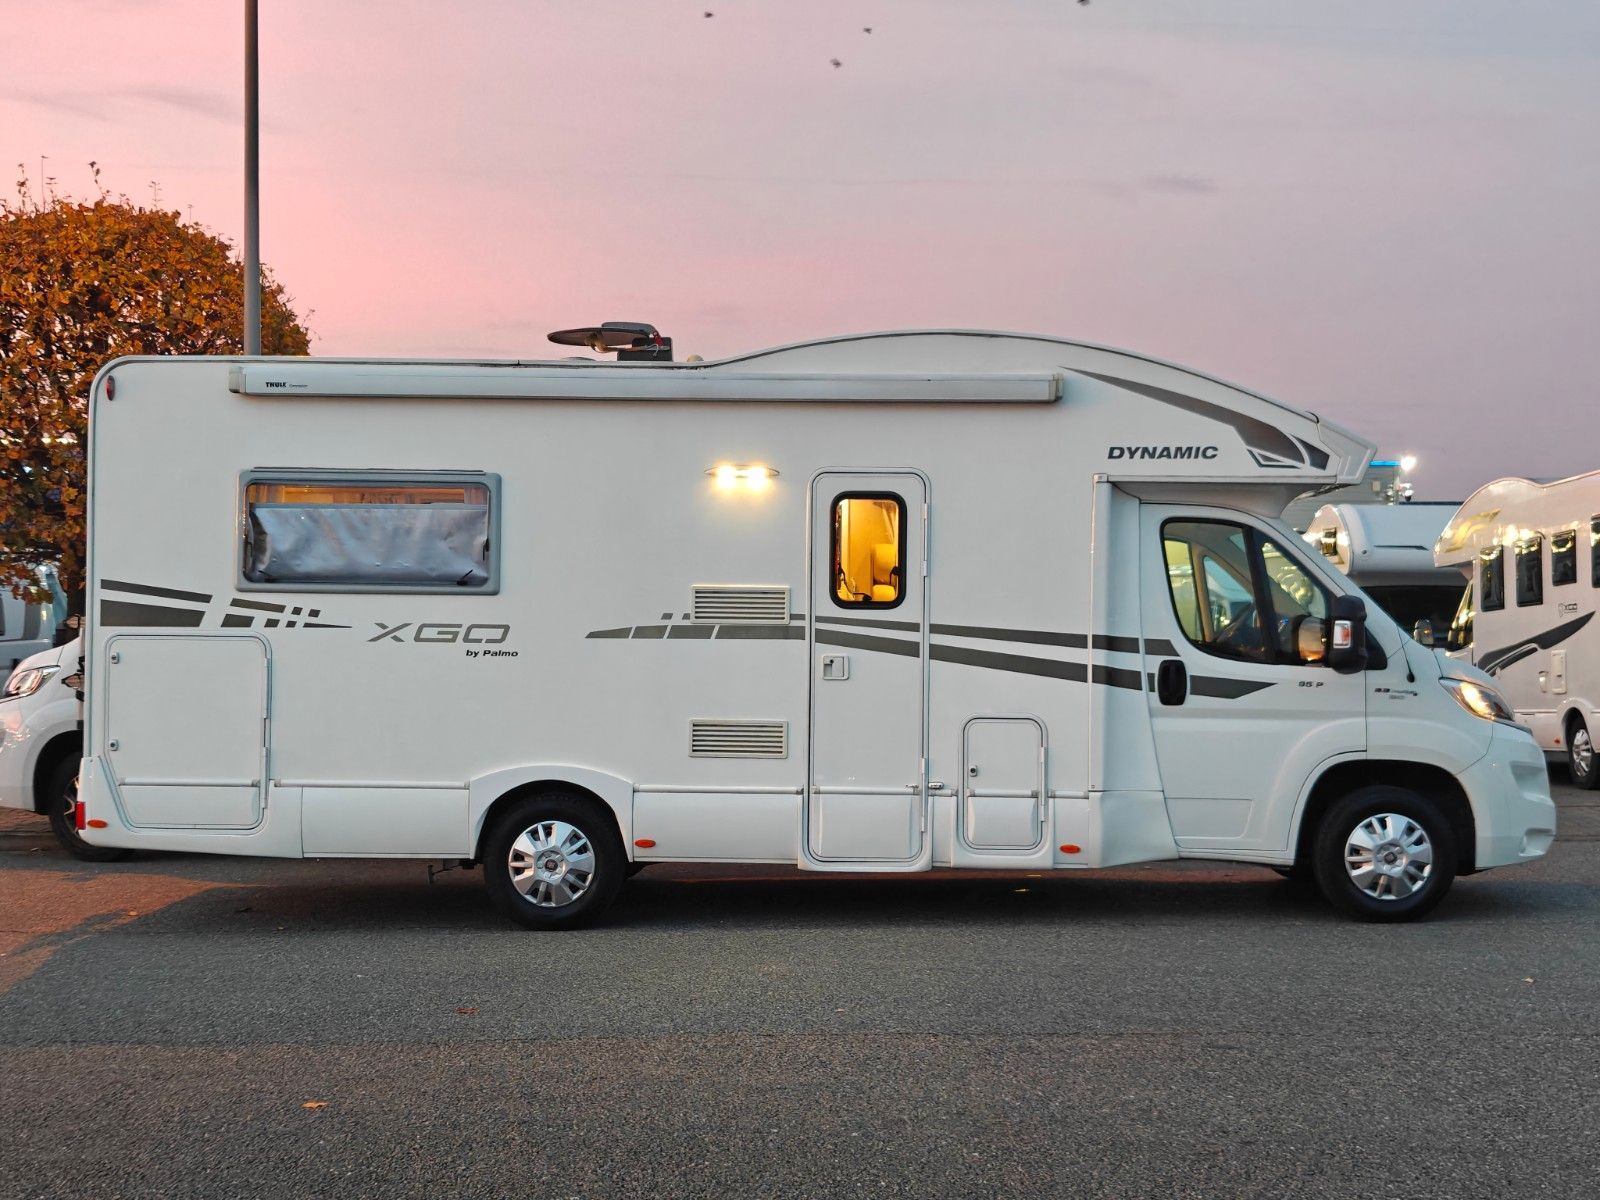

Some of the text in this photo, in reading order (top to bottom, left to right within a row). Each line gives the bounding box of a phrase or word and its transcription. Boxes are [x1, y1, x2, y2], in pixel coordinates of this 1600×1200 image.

[1107, 446, 1219, 460] DYNAMIC
[366, 622, 511, 643] XGO
[466, 649, 519, 658] by Palmo
